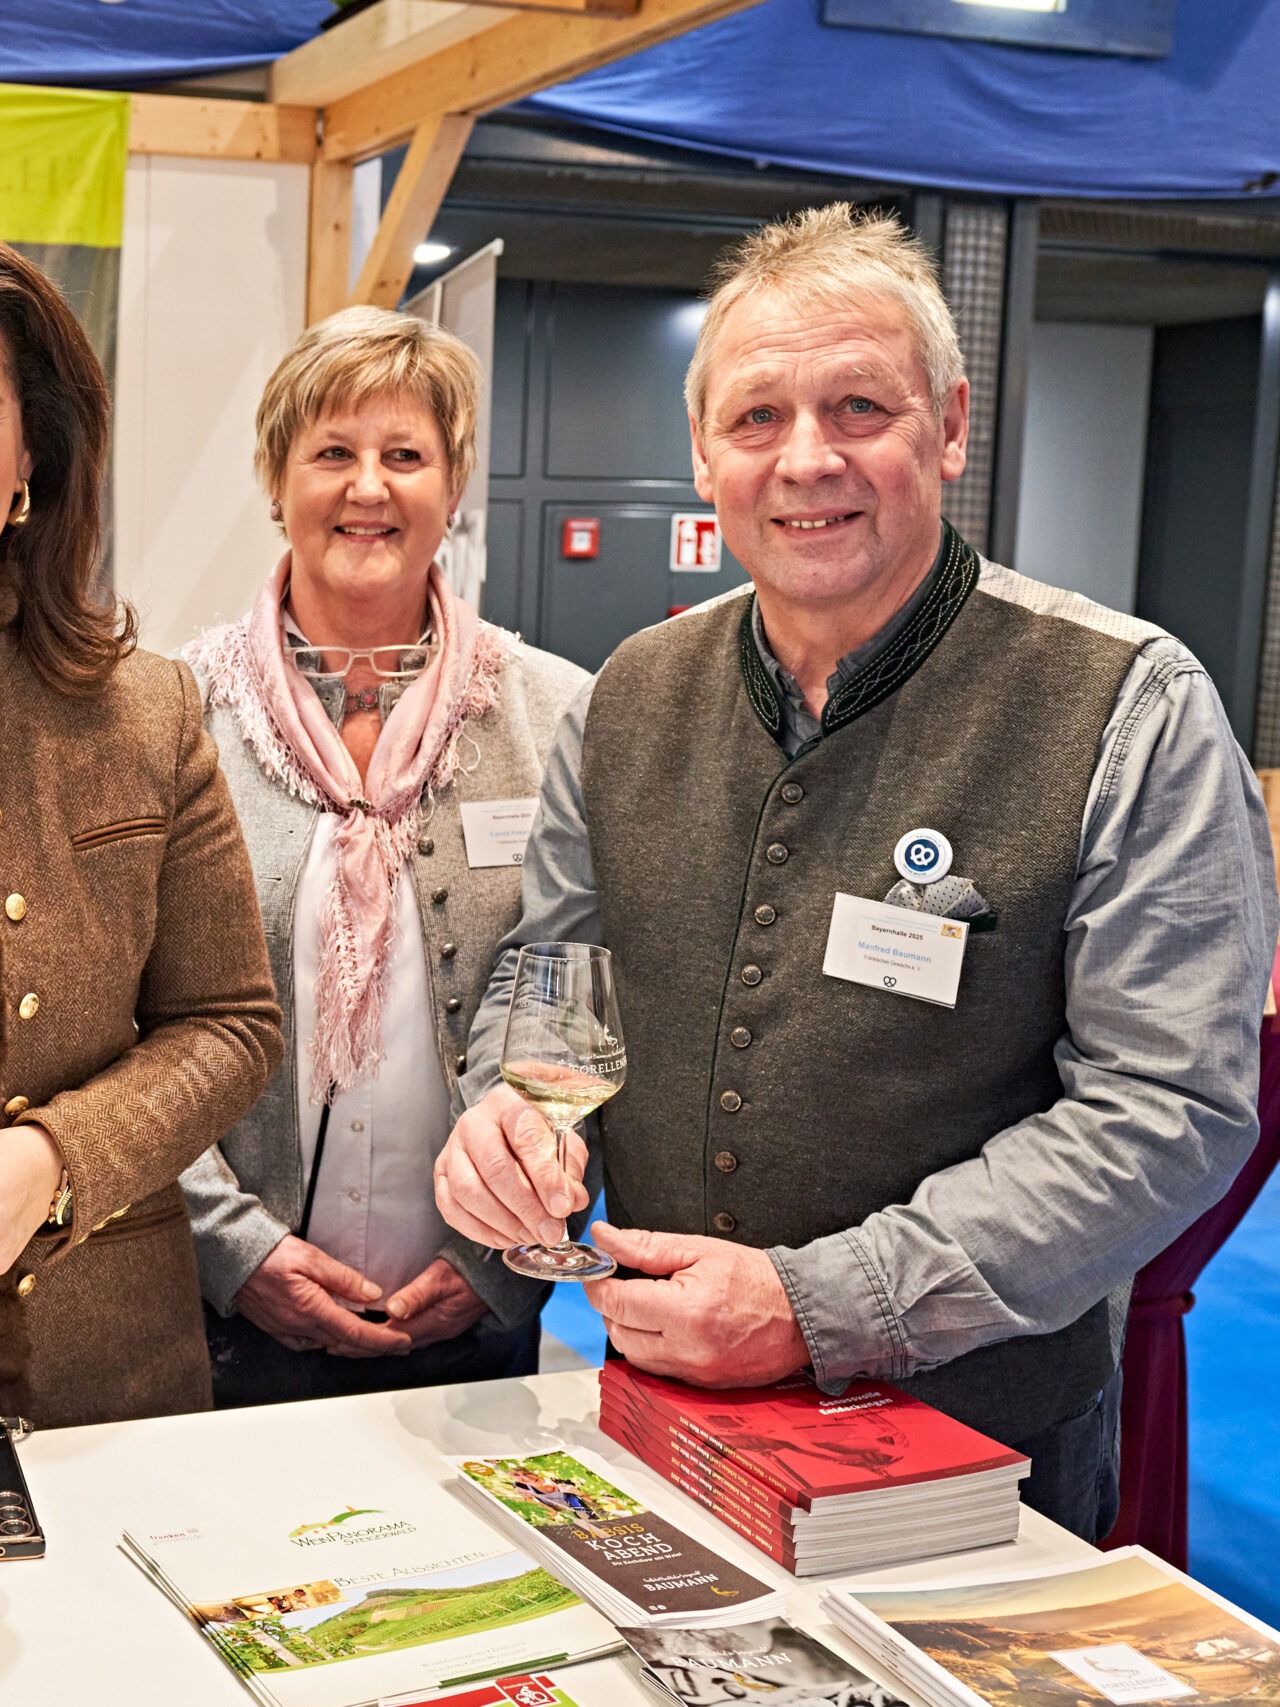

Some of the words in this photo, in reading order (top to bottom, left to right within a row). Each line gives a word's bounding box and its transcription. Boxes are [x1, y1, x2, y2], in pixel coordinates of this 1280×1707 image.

[871, 924, 908, 938] Bayernhalle
[908, 932, 924, 941] 2025
[858, 941, 891, 955] Manfred
[892, 948, 932, 964] Baumann
[818, 1398, 893, 1415] Entdeckungen
[819, 1391, 882, 1407] Genussvolle
[585, 1532, 662, 1551] KOCH
[603, 1543, 673, 1561] ABEND
[643, 1573, 719, 1593] BAUMANN
[670, 1652, 792, 1669] BAUMANN
